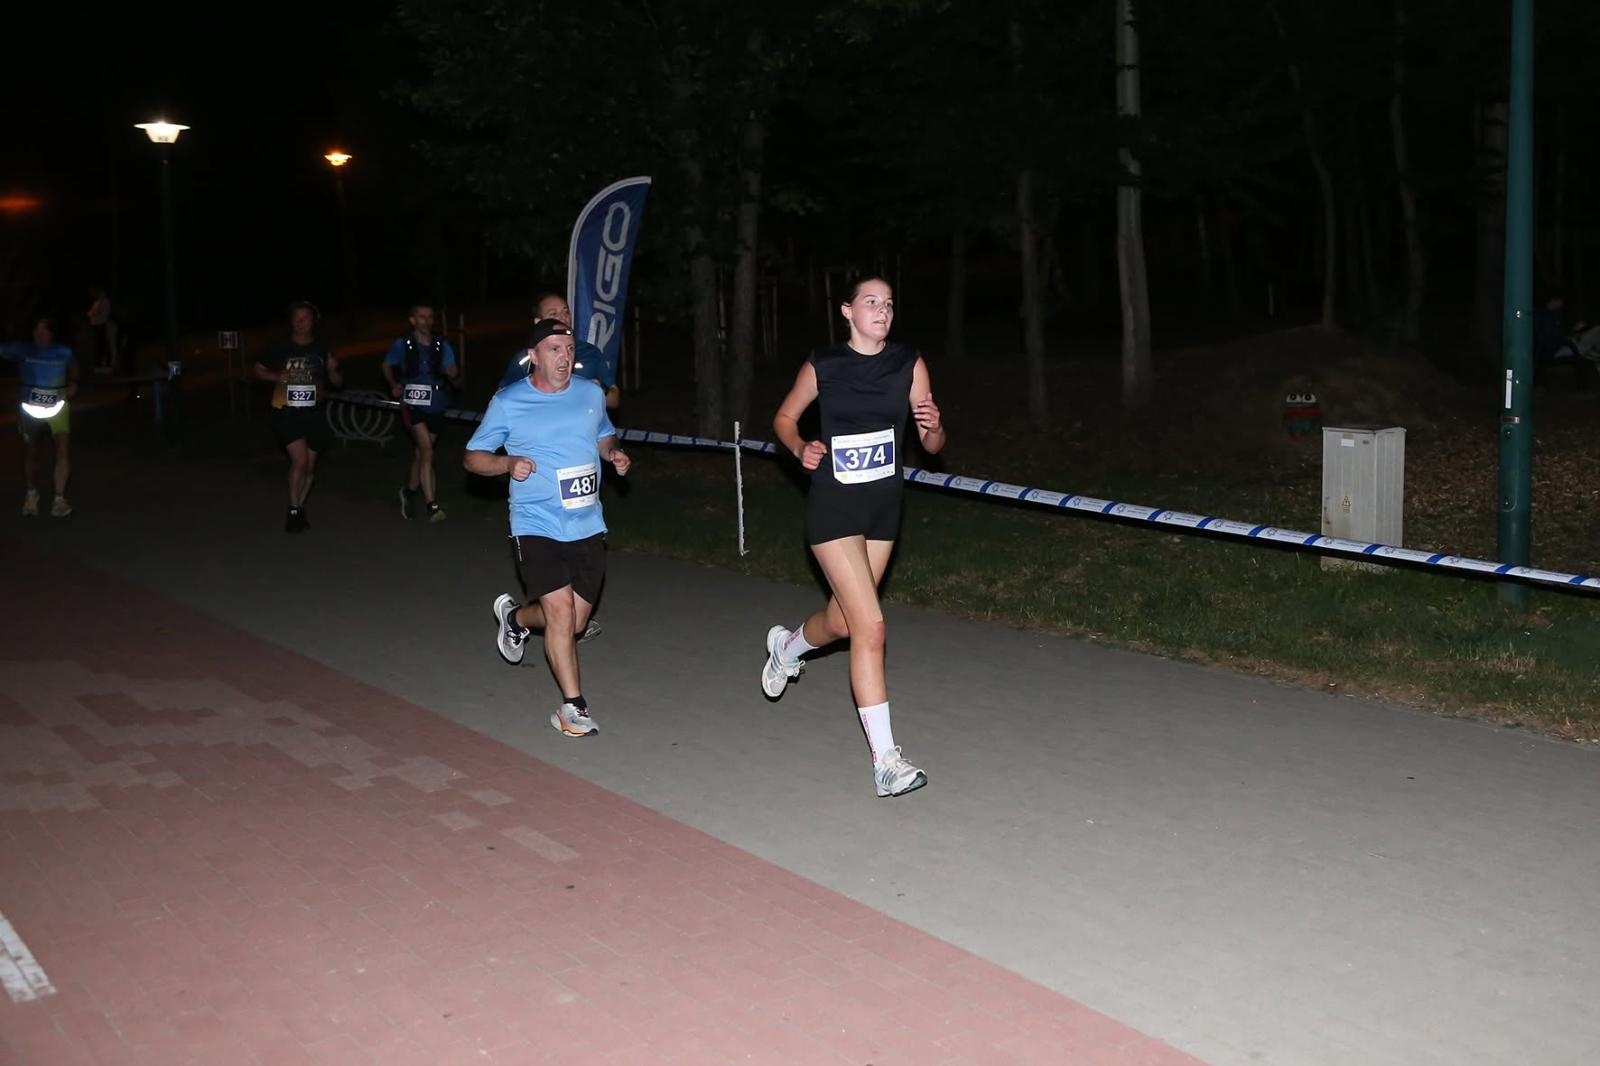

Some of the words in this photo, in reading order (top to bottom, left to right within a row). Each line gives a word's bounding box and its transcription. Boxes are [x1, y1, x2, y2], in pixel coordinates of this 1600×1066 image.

[291, 391, 312, 401] 327
[408, 390, 428, 399] 409
[845, 445, 886, 469] 374
[570, 475, 596, 495] 487
